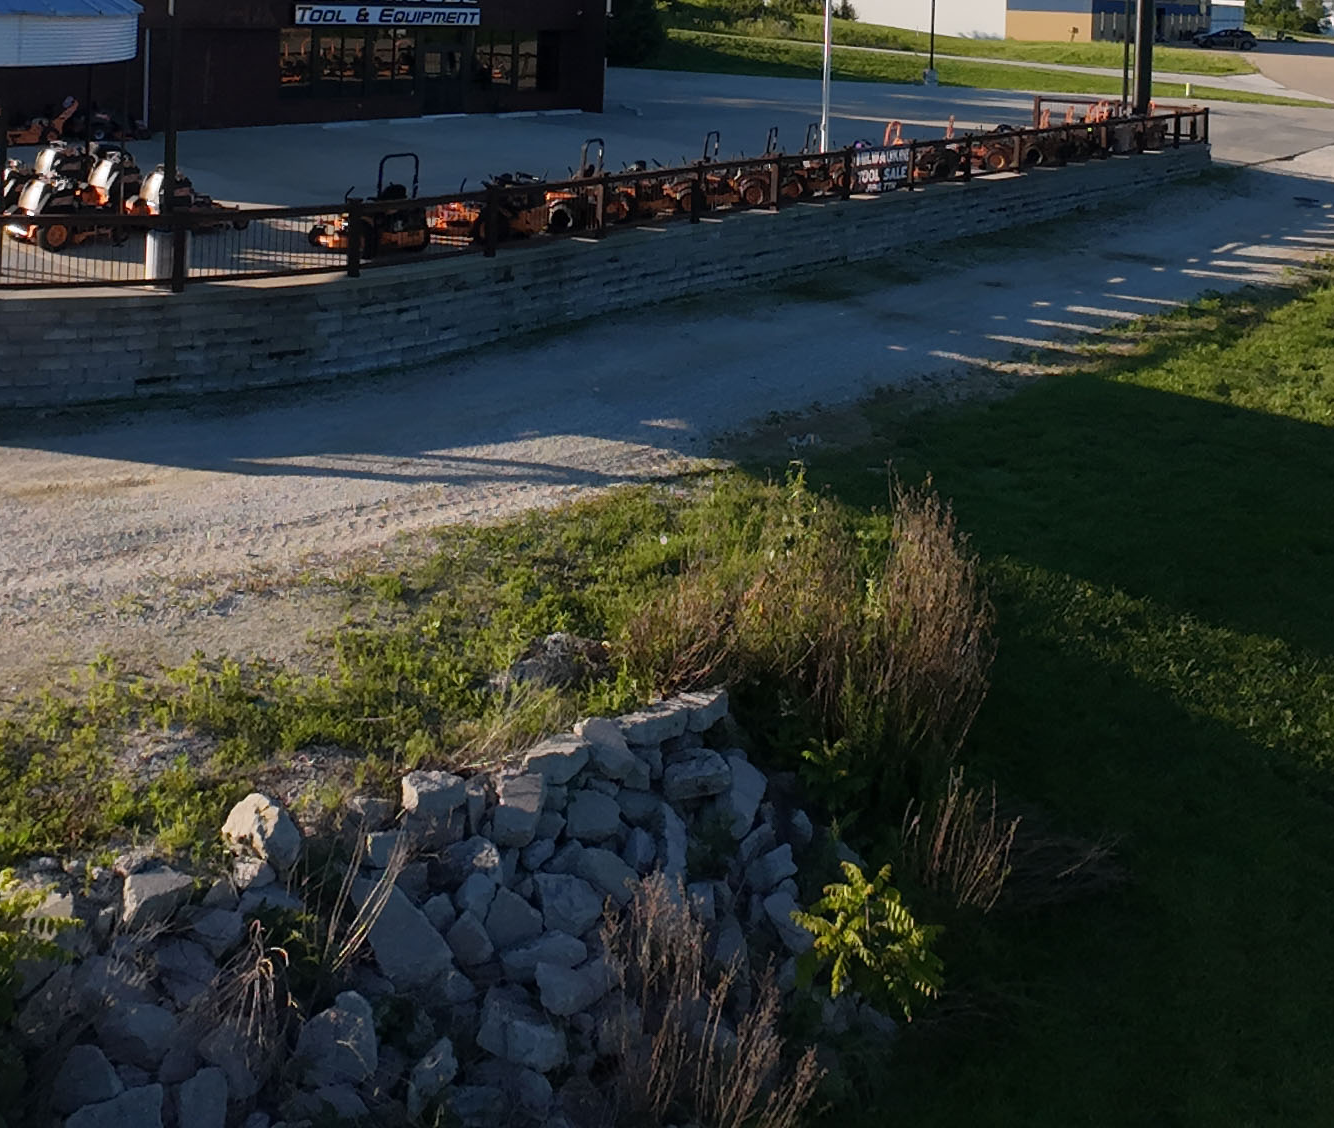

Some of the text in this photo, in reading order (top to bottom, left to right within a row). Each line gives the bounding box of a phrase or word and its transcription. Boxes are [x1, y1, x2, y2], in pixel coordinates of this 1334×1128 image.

[297, 7, 479, 24] TOOL & EQUIPMENT
[857, 165, 908, 184] TOOL SALE
